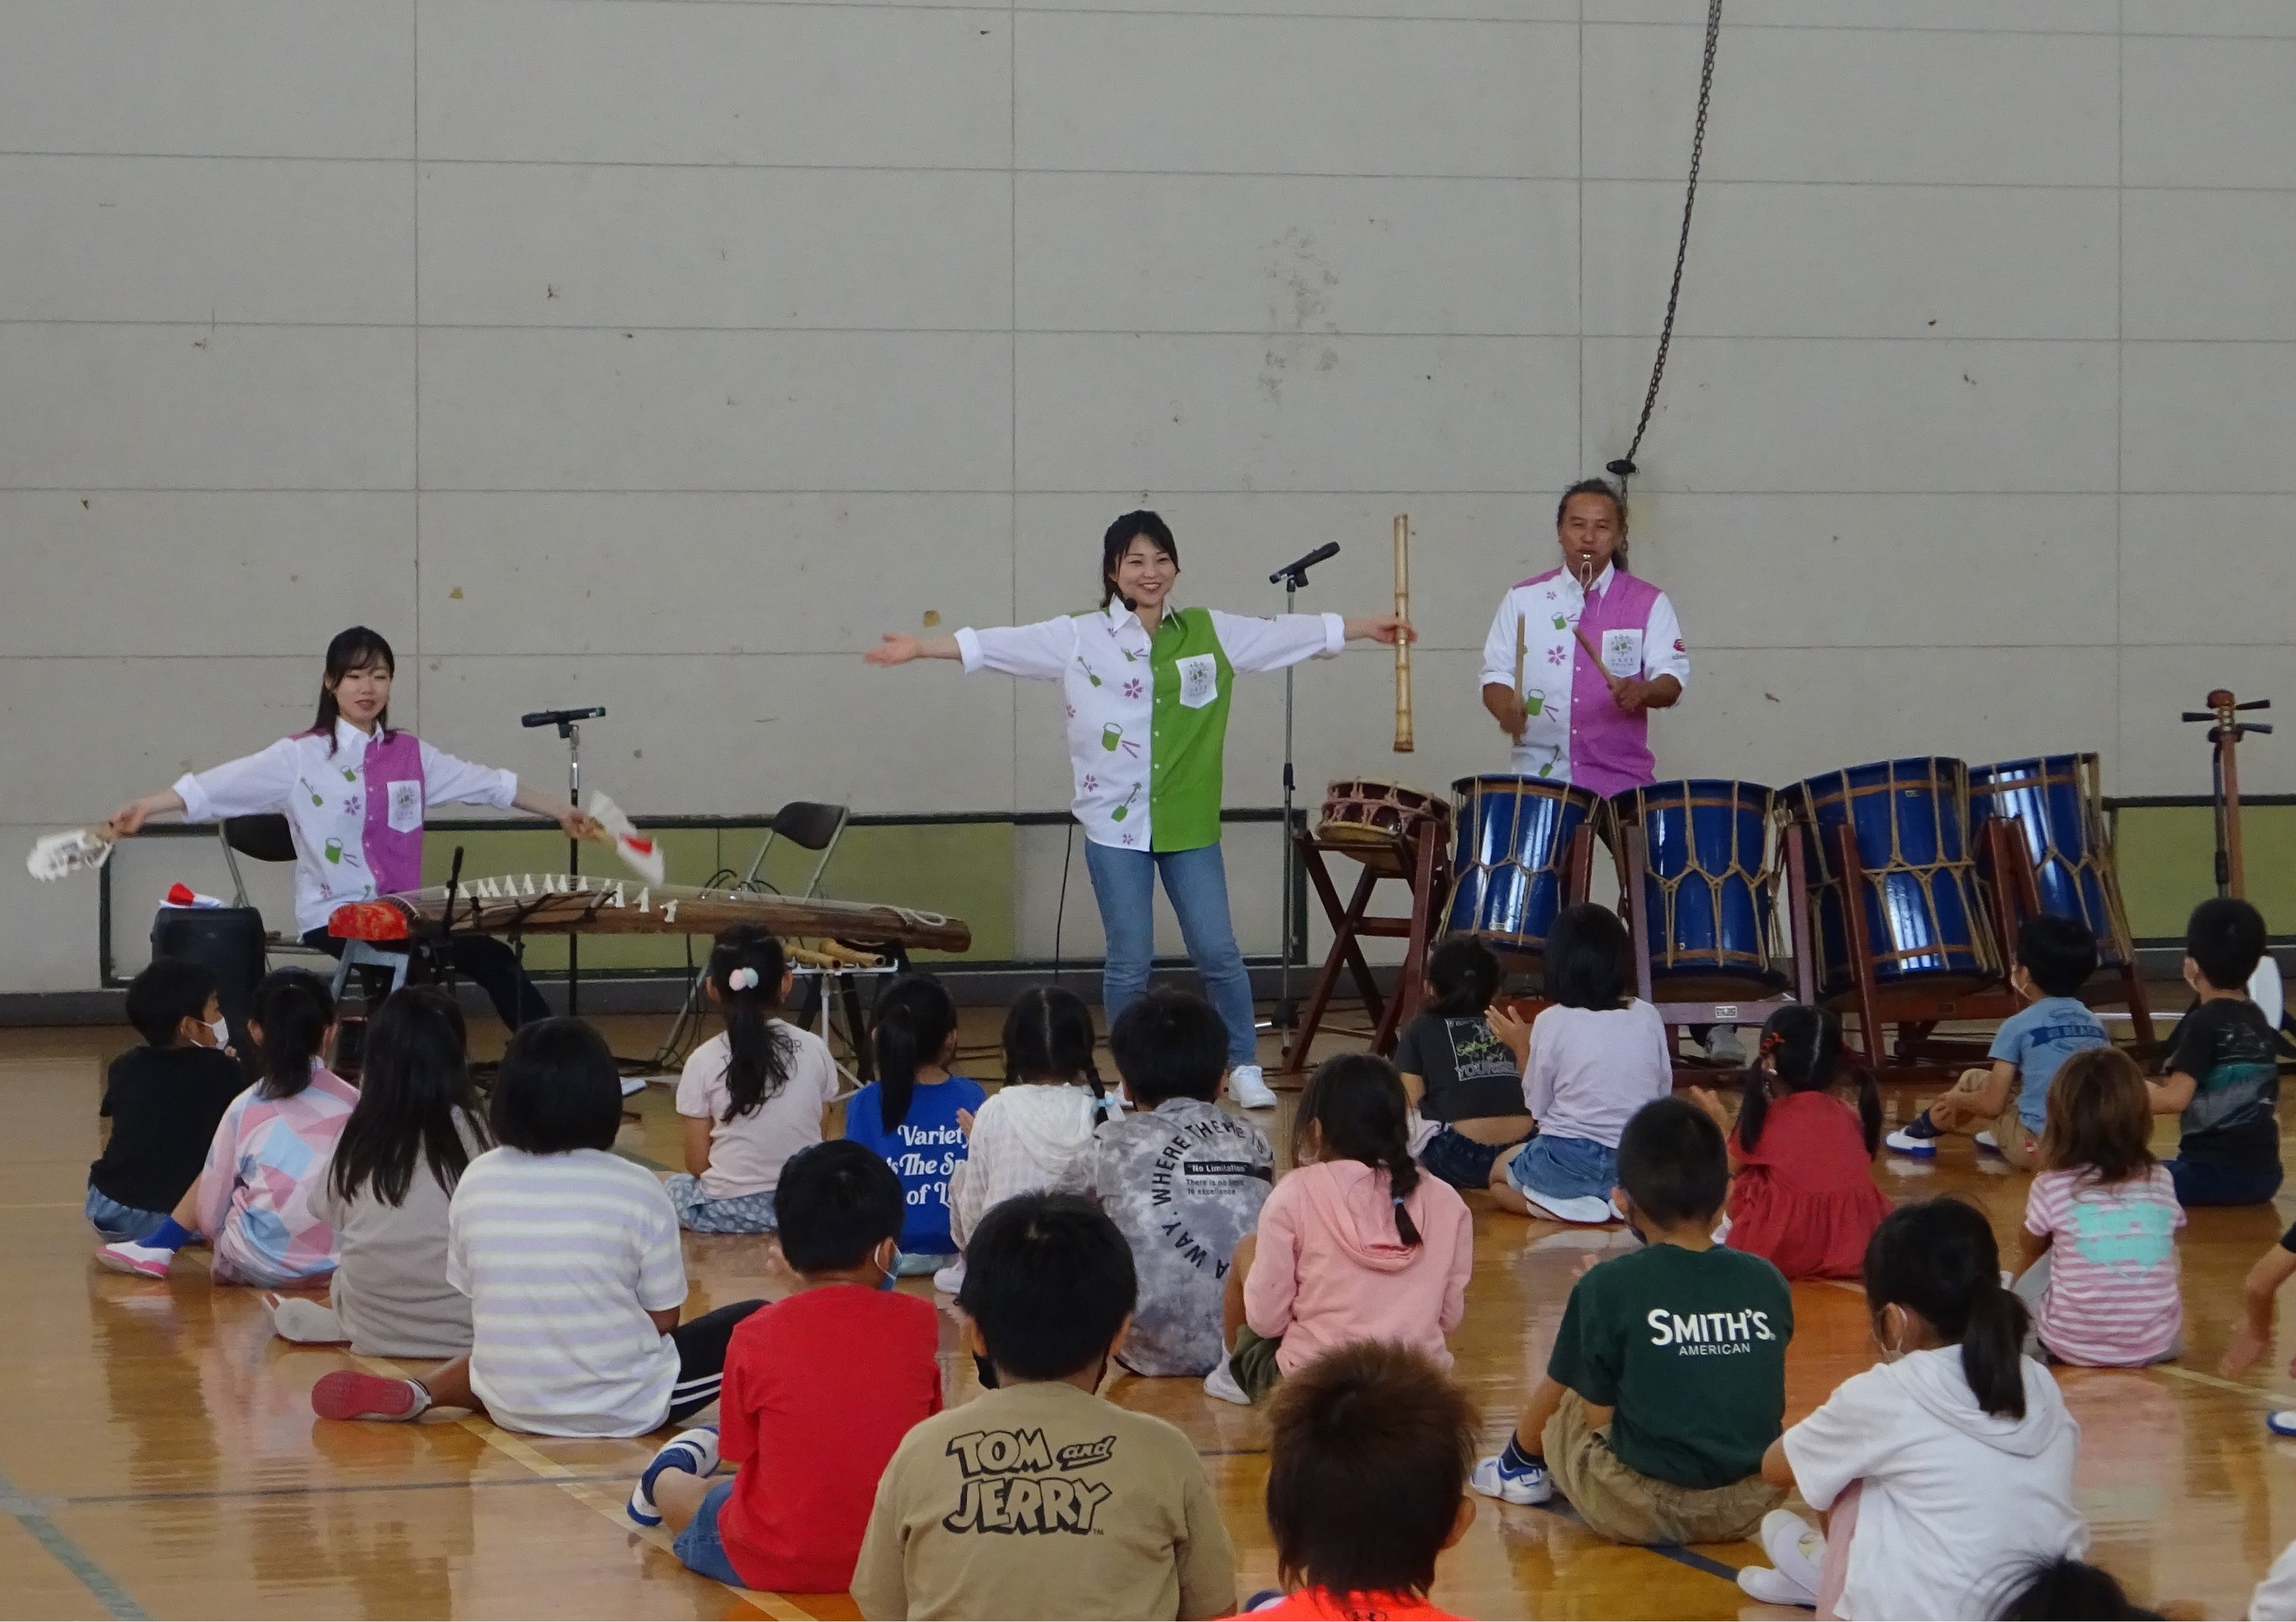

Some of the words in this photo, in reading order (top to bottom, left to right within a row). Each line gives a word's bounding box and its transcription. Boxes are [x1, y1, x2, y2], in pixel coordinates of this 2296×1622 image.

[899, 1153, 938, 1176] The
[940, 1152, 967, 1175] S
[1152, 1135, 1192, 1206] WHERE
[907, 1184, 931, 1205] of
[1216, 1259, 1230, 1279] A
[1648, 1308, 1769, 1346] SMITH'S
[1679, 1343, 1750, 1356] AMERICAN
[945, 1428, 1053, 1478] TOM
[1056, 1435, 1117, 1472] and
[942, 1477, 1113, 1535] JERRY
